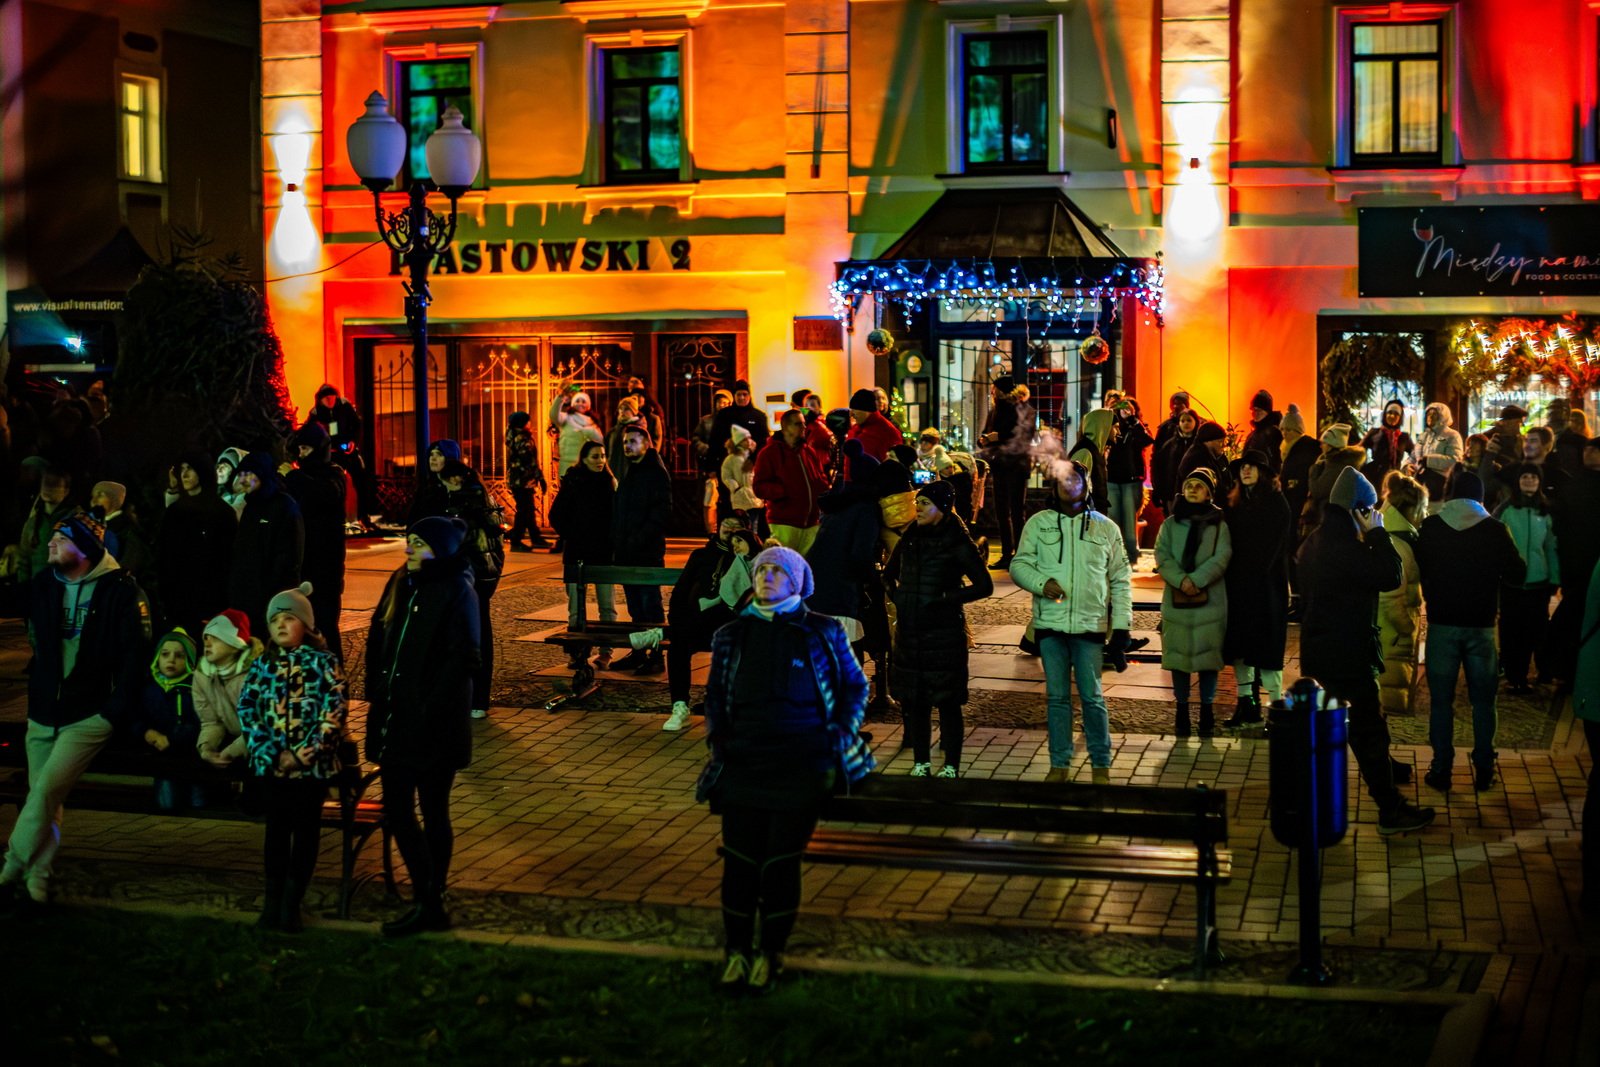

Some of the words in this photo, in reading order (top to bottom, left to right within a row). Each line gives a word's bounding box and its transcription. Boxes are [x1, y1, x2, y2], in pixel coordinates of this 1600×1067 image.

[389, 239, 650, 276] PASTOWSKI
[671, 239, 691, 271] 2
[1525, 273, 1552, 281] FOOD
